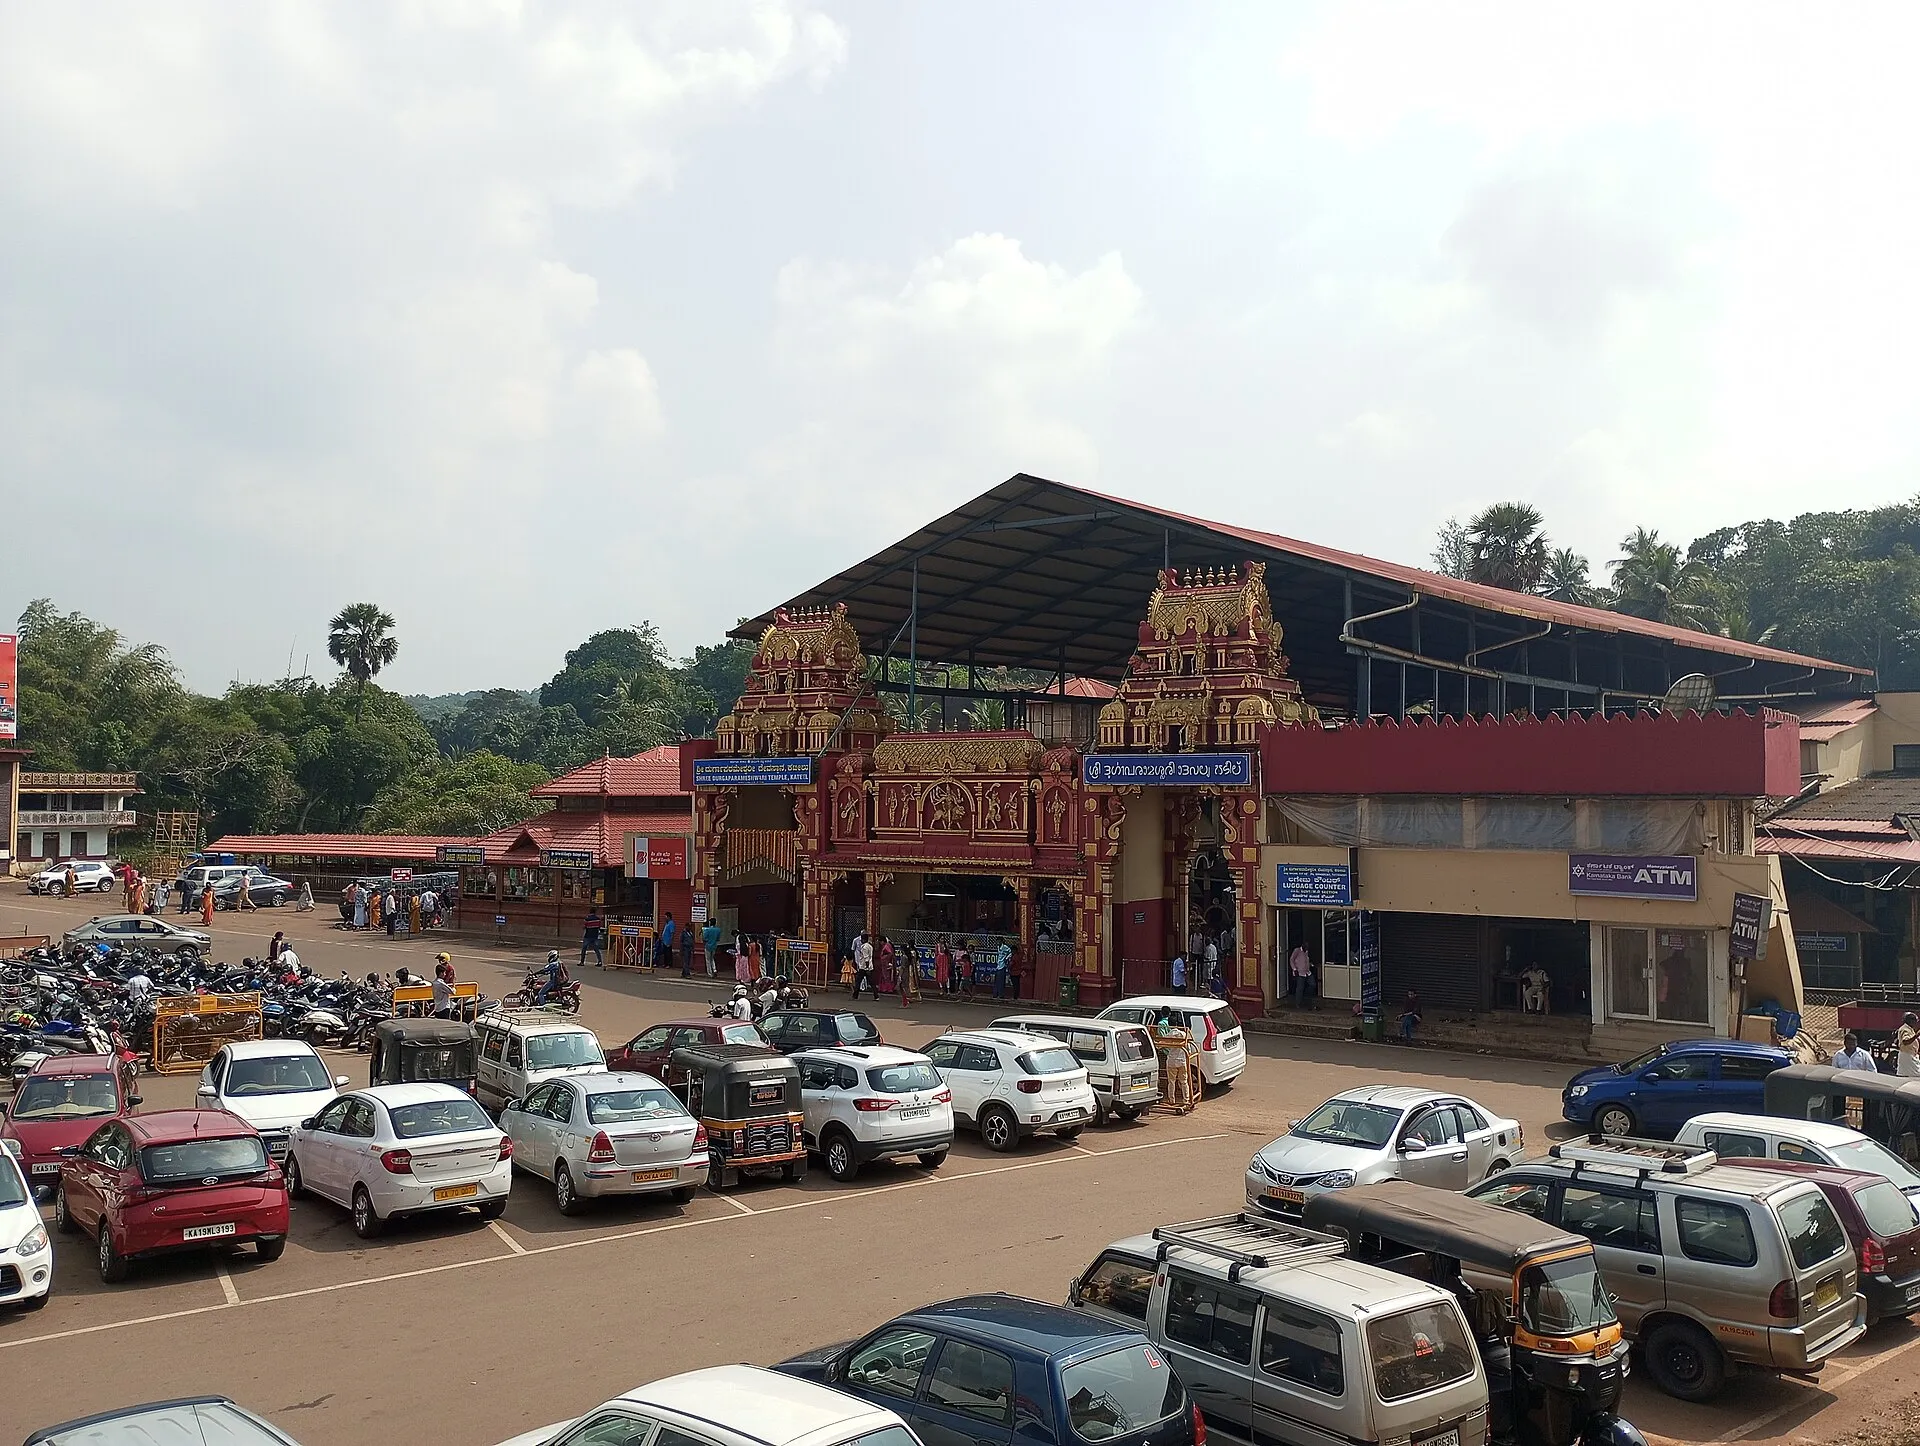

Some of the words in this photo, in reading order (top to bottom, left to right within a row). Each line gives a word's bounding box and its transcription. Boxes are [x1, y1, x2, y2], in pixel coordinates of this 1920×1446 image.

[1633, 868, 1692, 886] ATM
[1282, 882, 1314, 890] LUGGAGE
[1732, 922, 1758, 940] ATM
[188, 1224, 234, 1238] KA19ML3193
